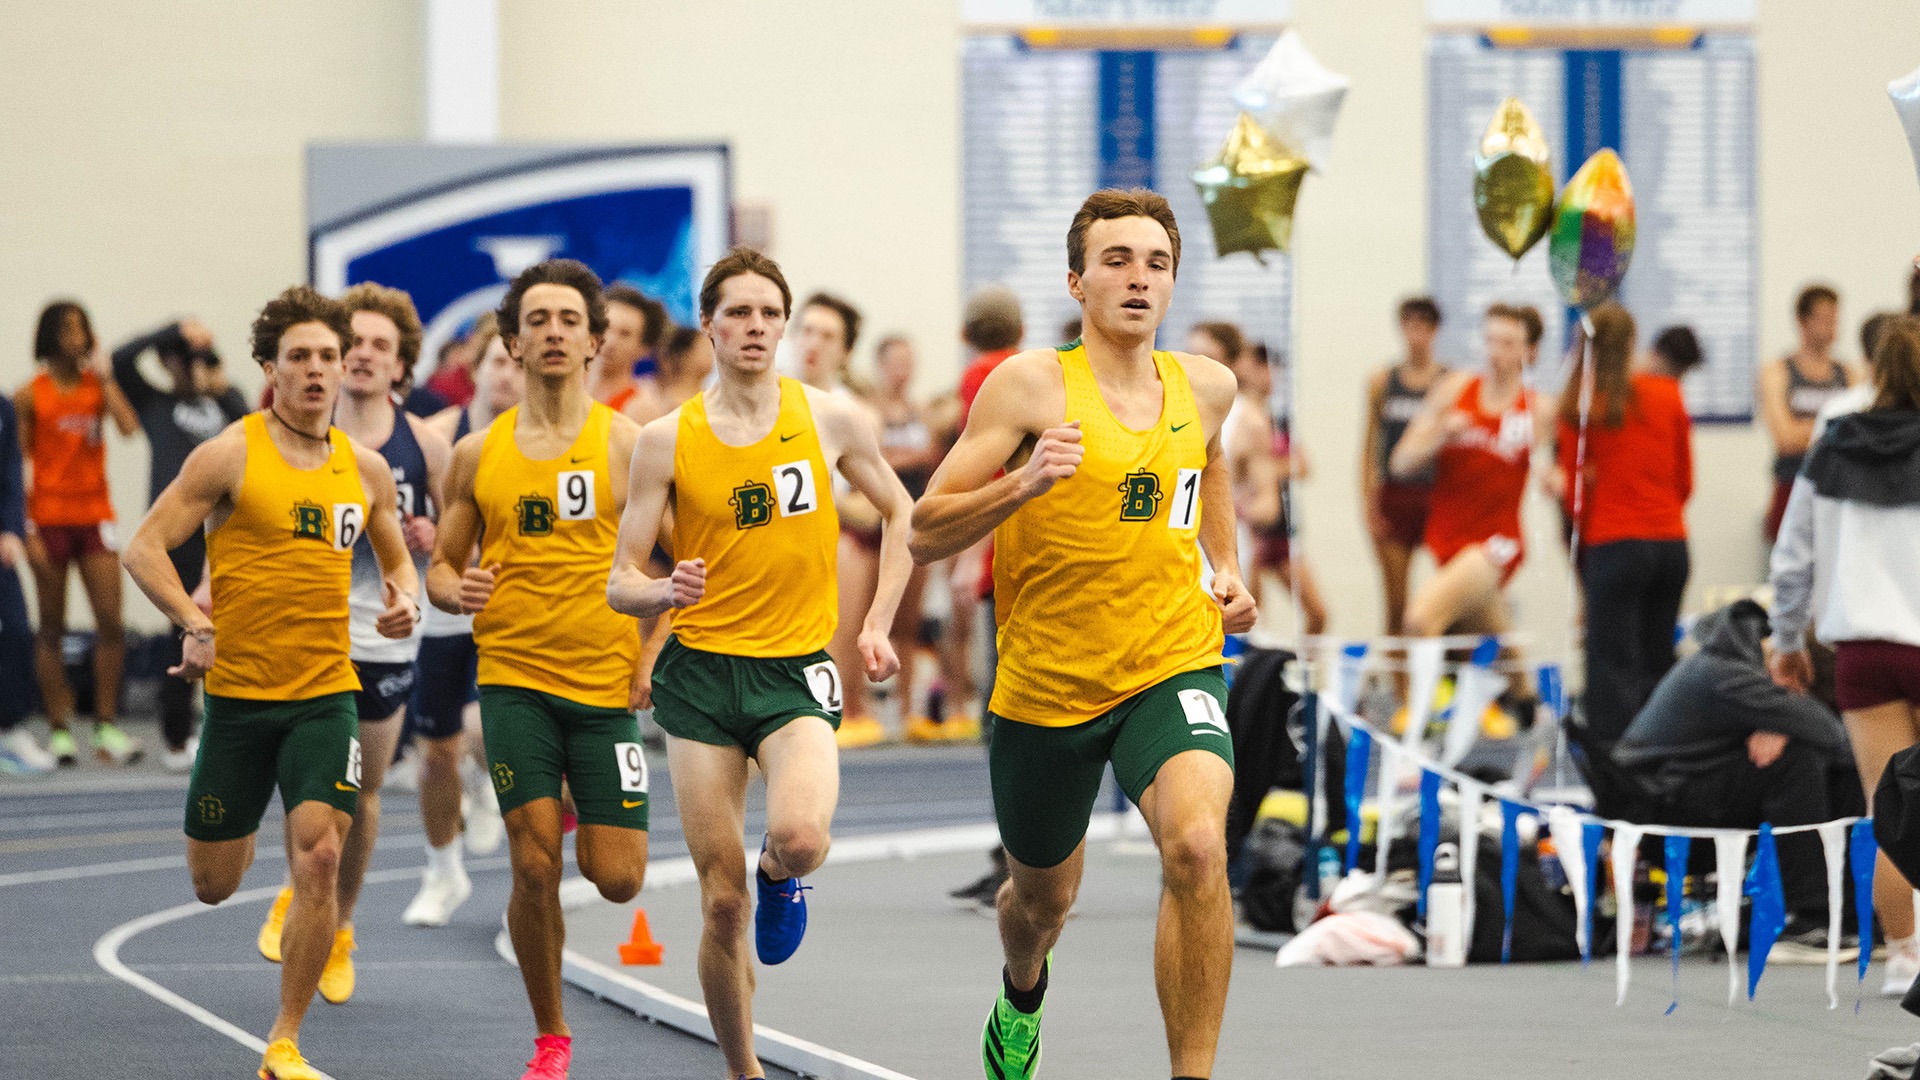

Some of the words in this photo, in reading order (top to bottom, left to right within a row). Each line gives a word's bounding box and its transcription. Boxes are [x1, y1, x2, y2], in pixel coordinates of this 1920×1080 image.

[566, 474, 587, 516] 9
[733, 482, 772, 531] B
[781, 467, 810, 513] 2
[1120, 471, 1160, 521] B
[1184, 473, 1197, 525] 1
[293, 502, 327, 539] B
[341, 507, 356, 548] 6
[518, 495, 553, 537] B
[814, 665, 841, 708] 2
[1193, 693, 1216, 722] 1
[626, 746, 643, 787] 9
